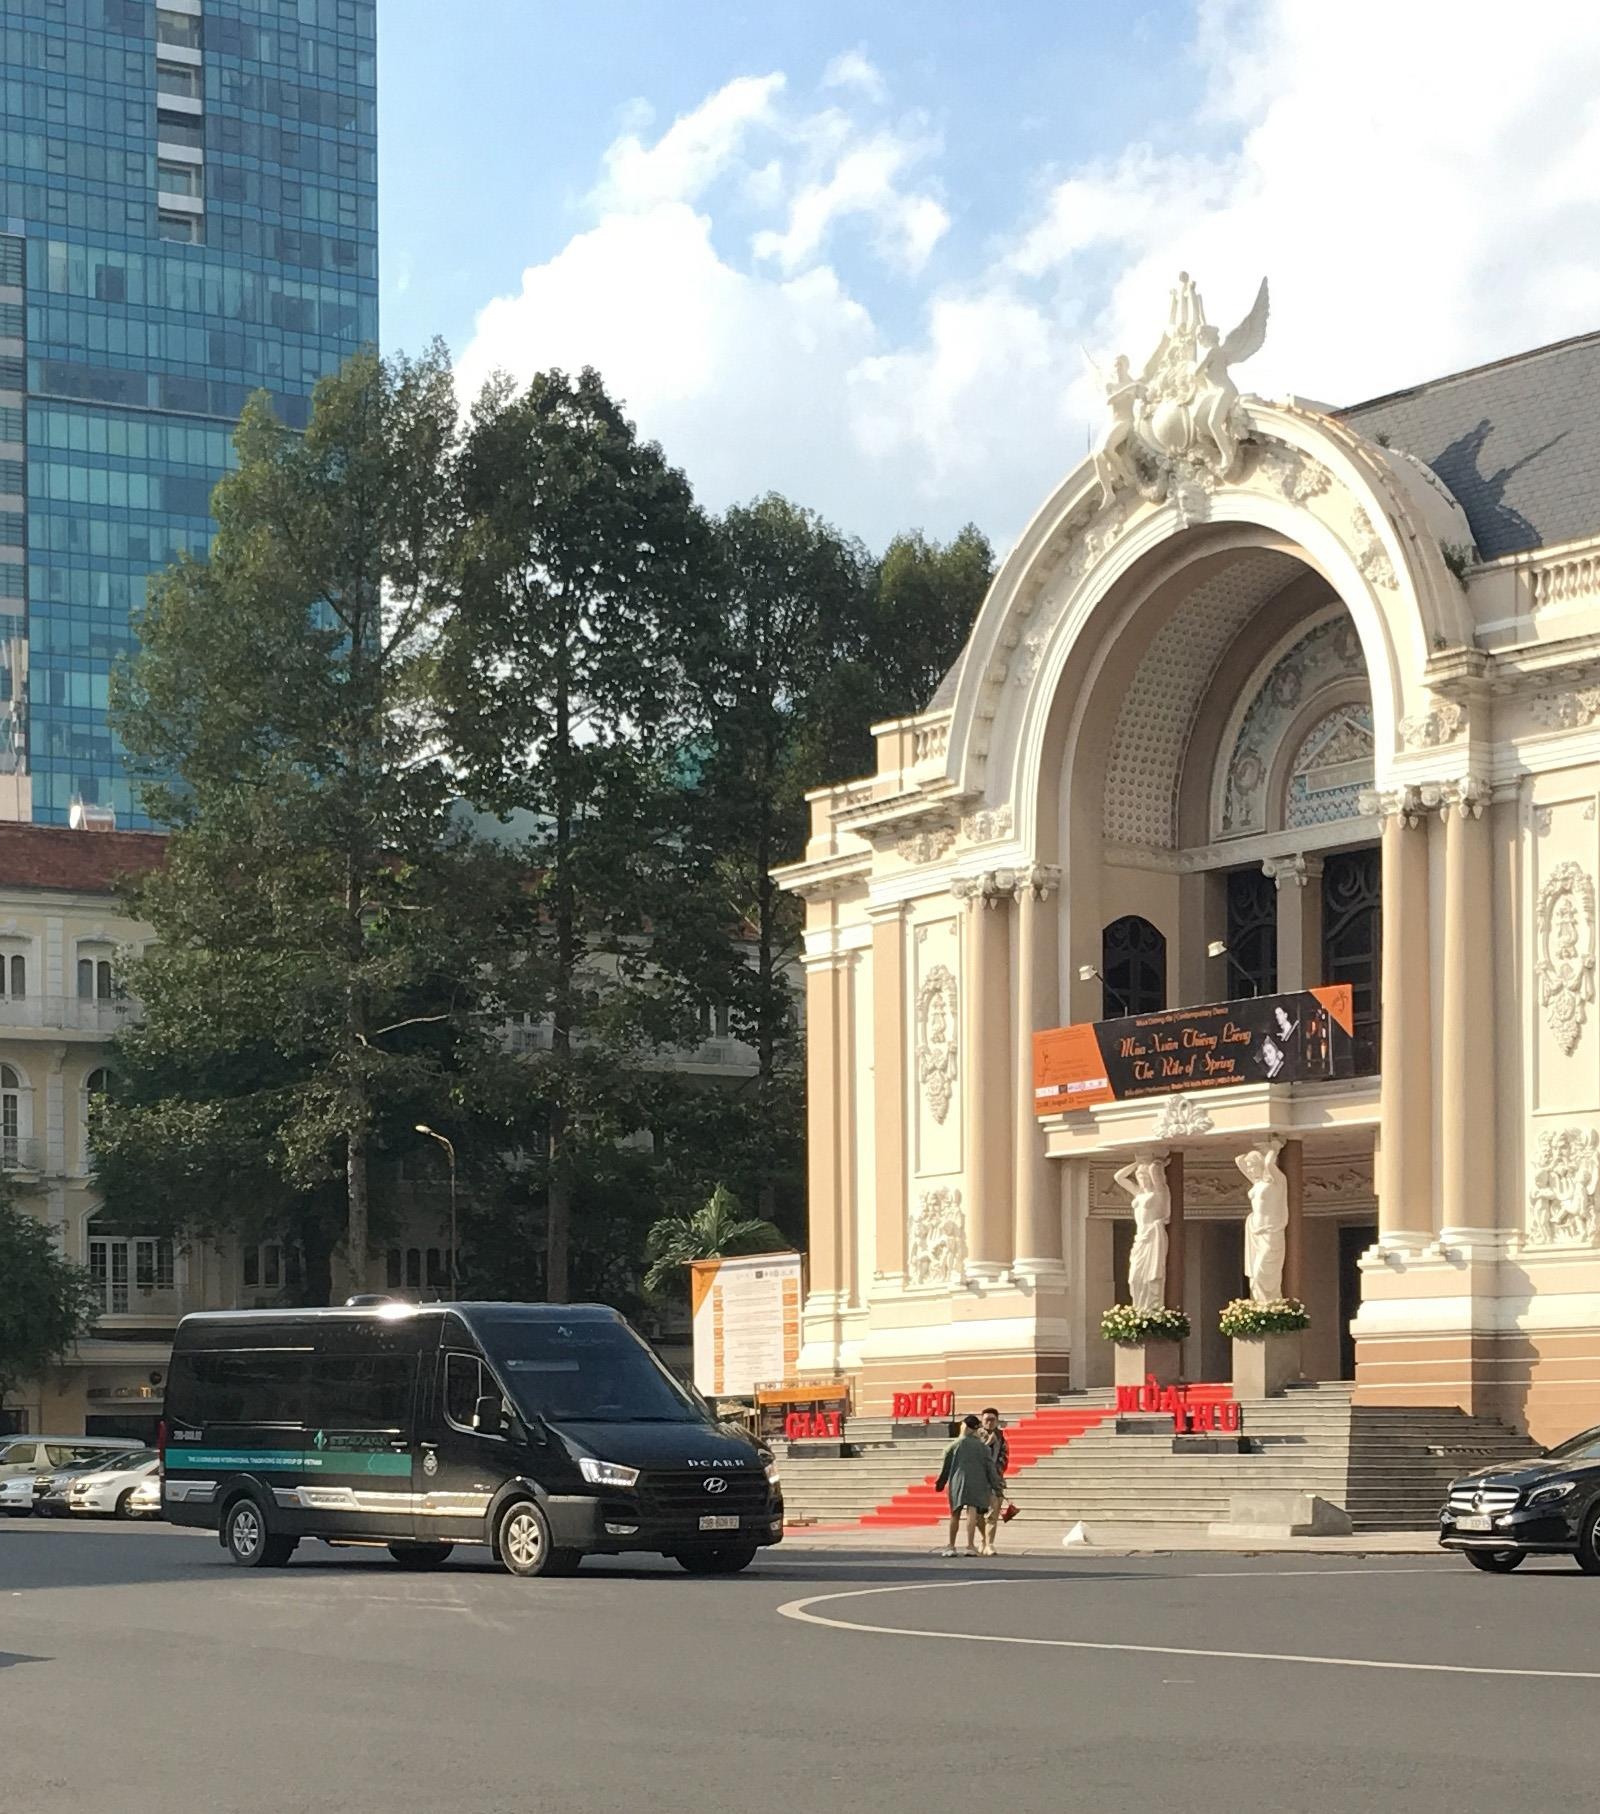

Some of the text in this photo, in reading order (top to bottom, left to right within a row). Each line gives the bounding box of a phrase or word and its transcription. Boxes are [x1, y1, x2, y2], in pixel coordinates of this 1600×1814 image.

[1134, 1051, 1235, 1080] The Rite of Spring
